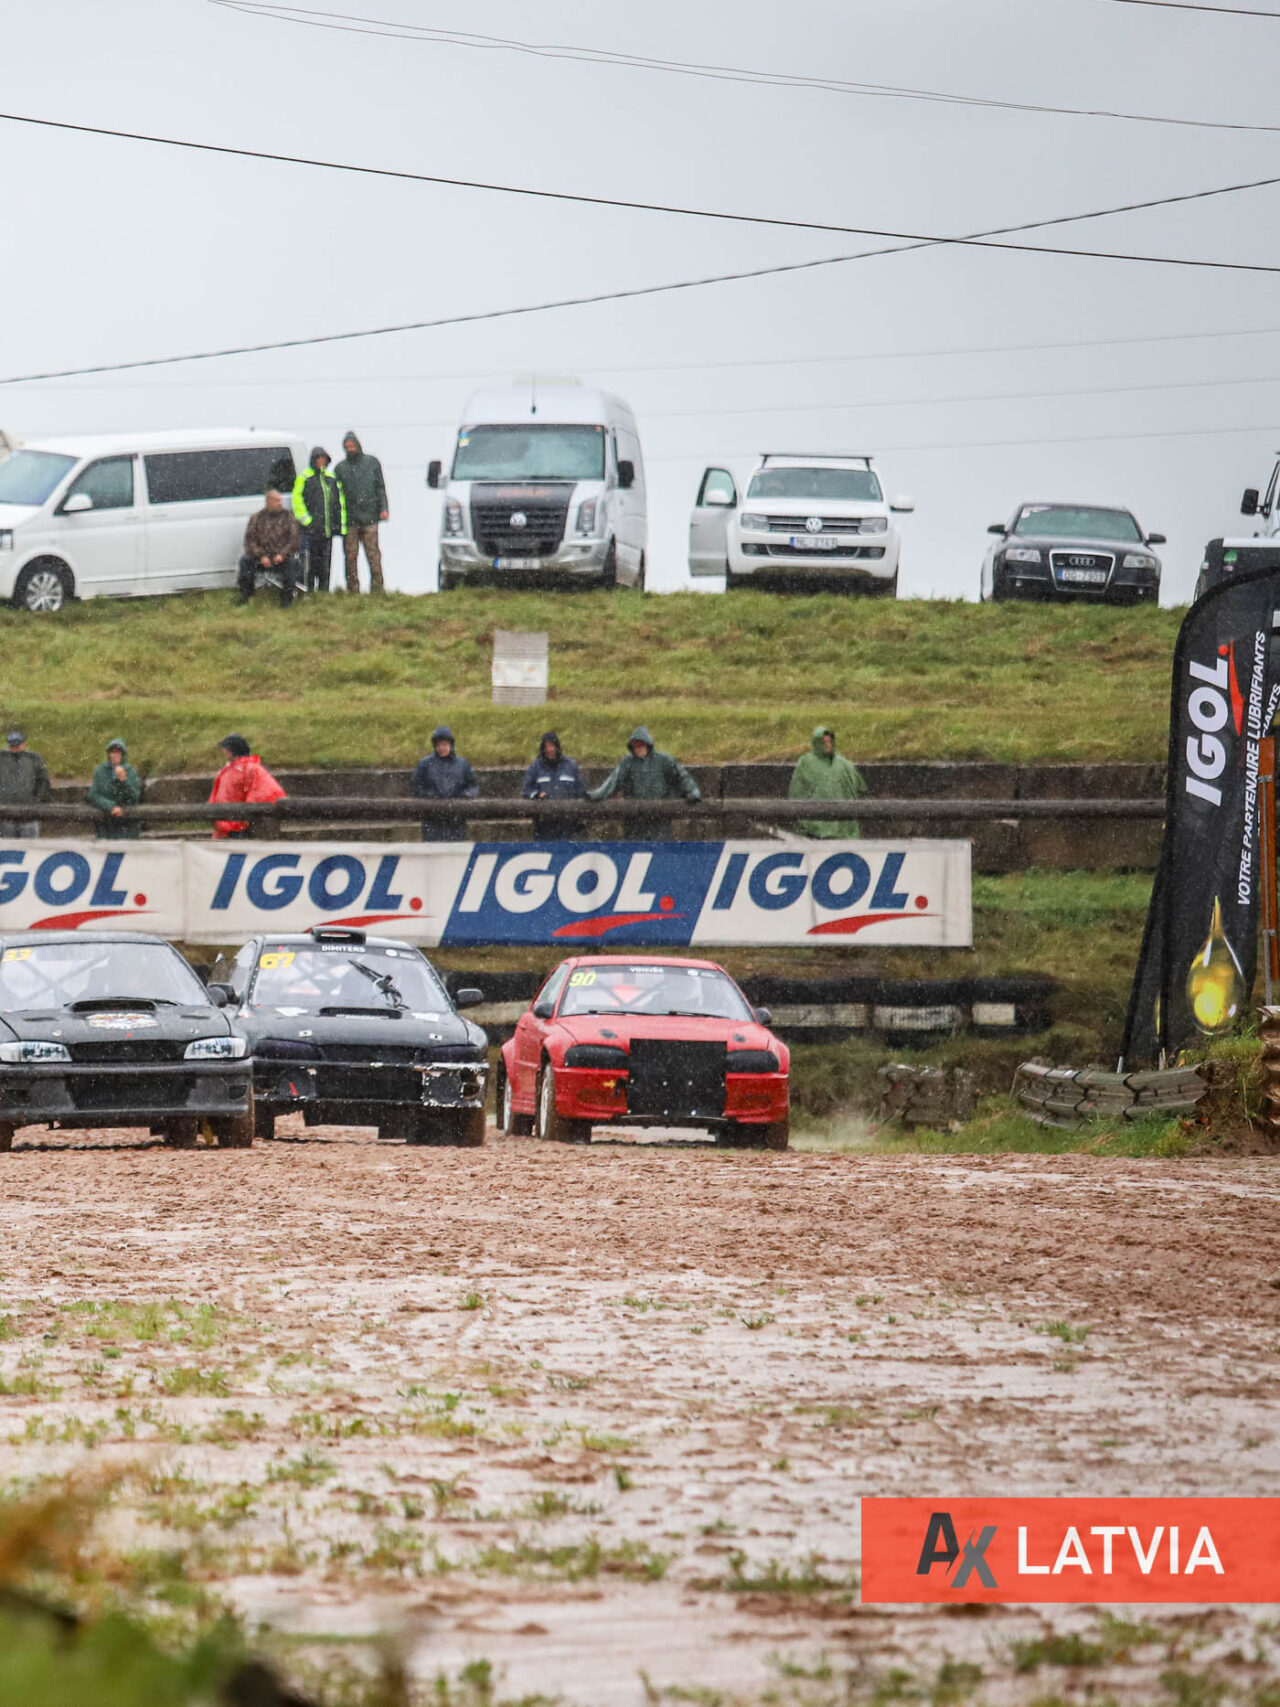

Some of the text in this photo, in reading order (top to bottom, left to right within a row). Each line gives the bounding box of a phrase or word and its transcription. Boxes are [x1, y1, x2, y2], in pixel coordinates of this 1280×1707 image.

[1237, 630, 1266, 905] VOTRE PARTENAIRE LUBRIFIANTS
[3, 948, 32, 962] 33
[259, 951, 296, 969] 67
[568, 971, 598, 987] 90
